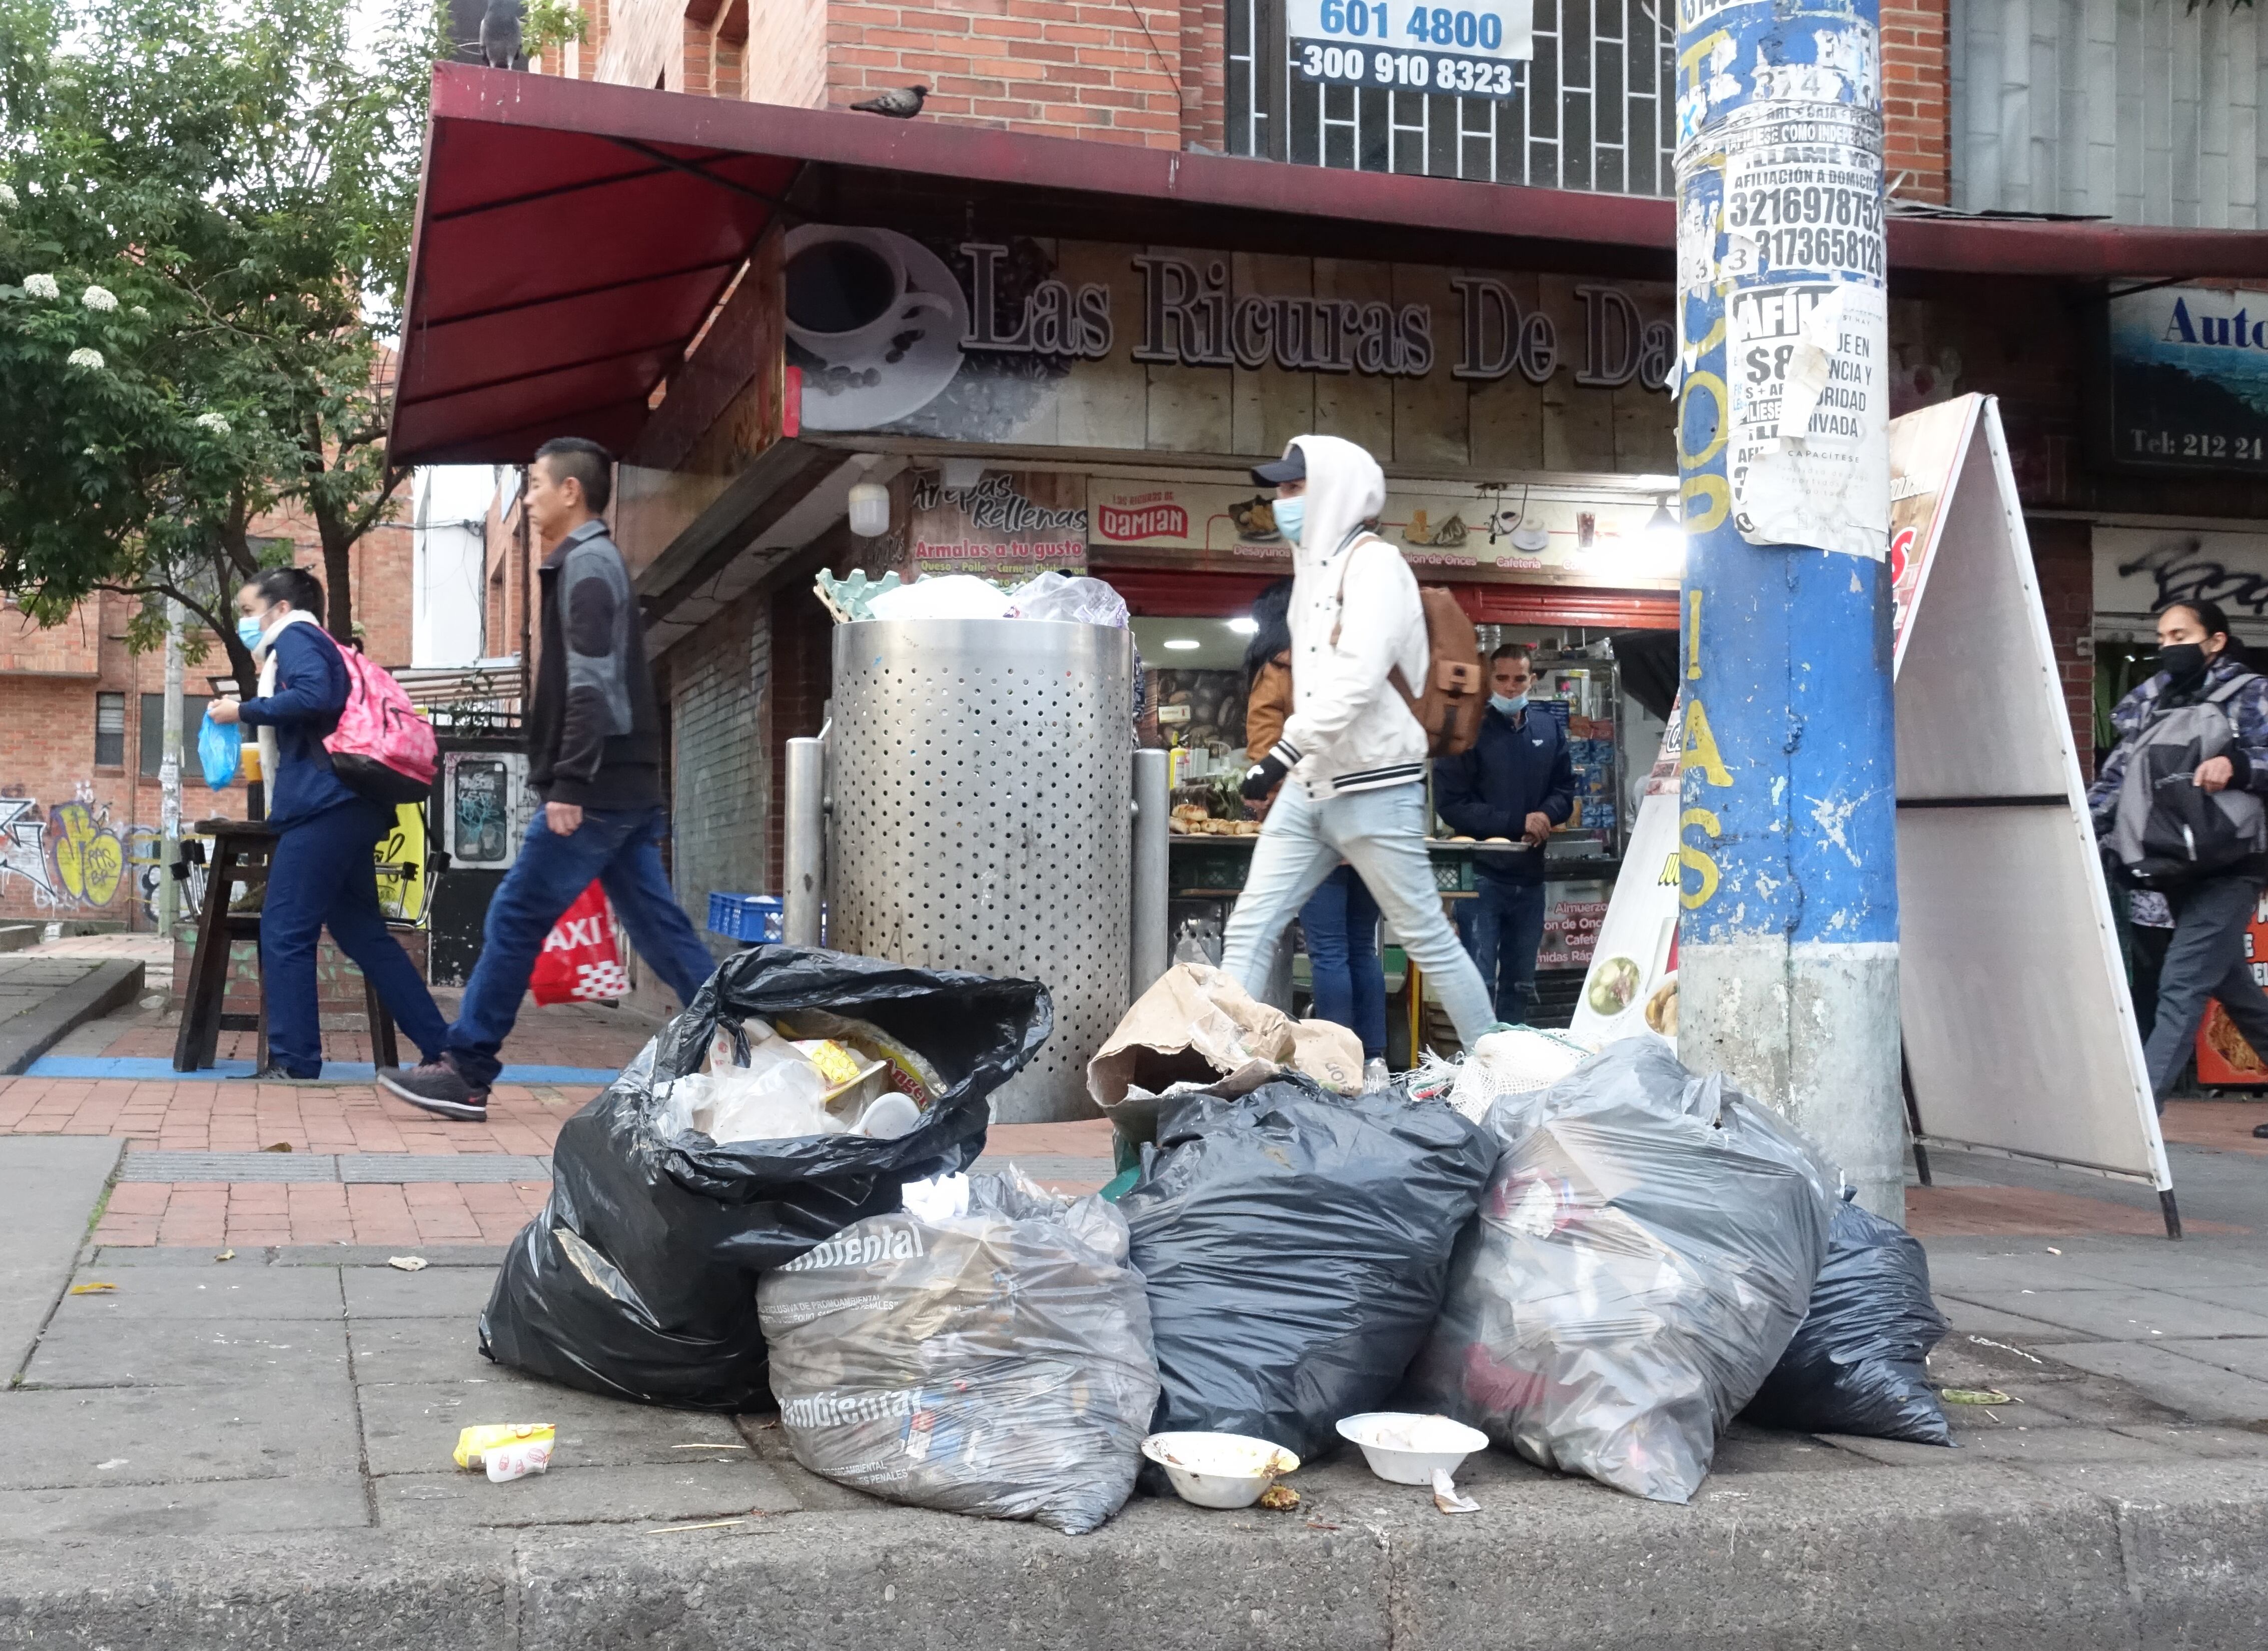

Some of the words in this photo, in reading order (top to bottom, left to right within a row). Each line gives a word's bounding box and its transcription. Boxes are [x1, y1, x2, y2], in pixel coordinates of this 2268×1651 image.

[1320, 0, 1387, 39] 601
[1407, 7, 1502, 50] 4800
[1304, 45, 1364, 79] 300
[1375, 53, 1428, 86] 910
[1437, 59, 1511, 95] 8323
[1782, 124, 1815, 143] COMO
[1734, 166, 1812, 189] AFILIACIÓN
[1816, 170, 1826, 184] A
[960, 242, 1114, 359] Las
[1132, 254, 1435, 377] Ricuras
[1452, 276, 1558, 384] De
[1855, 336, 1870, 358] EN
[1864, 365, 1872, 386] Y
[2130, 429, 2175, 454] Tel:
[2183, 434, 2226, 457] 212
[1788, 450, 1860, 464] CAPACÍTESE
[971, 493, 1088, 532] Rellenas
[994, 543, 1007, 558] a
[1011, 541, 1029, 557] tu
[1033, 539, 1083, 561] gusto
[1428, 553, 1442, 564] de
[1444, 554, 1477, 567] Onces
[921, 560, 952, 571] Queso
[962, 561, 987, 572] Pollo
[1562, 918, 1577, 930] de
